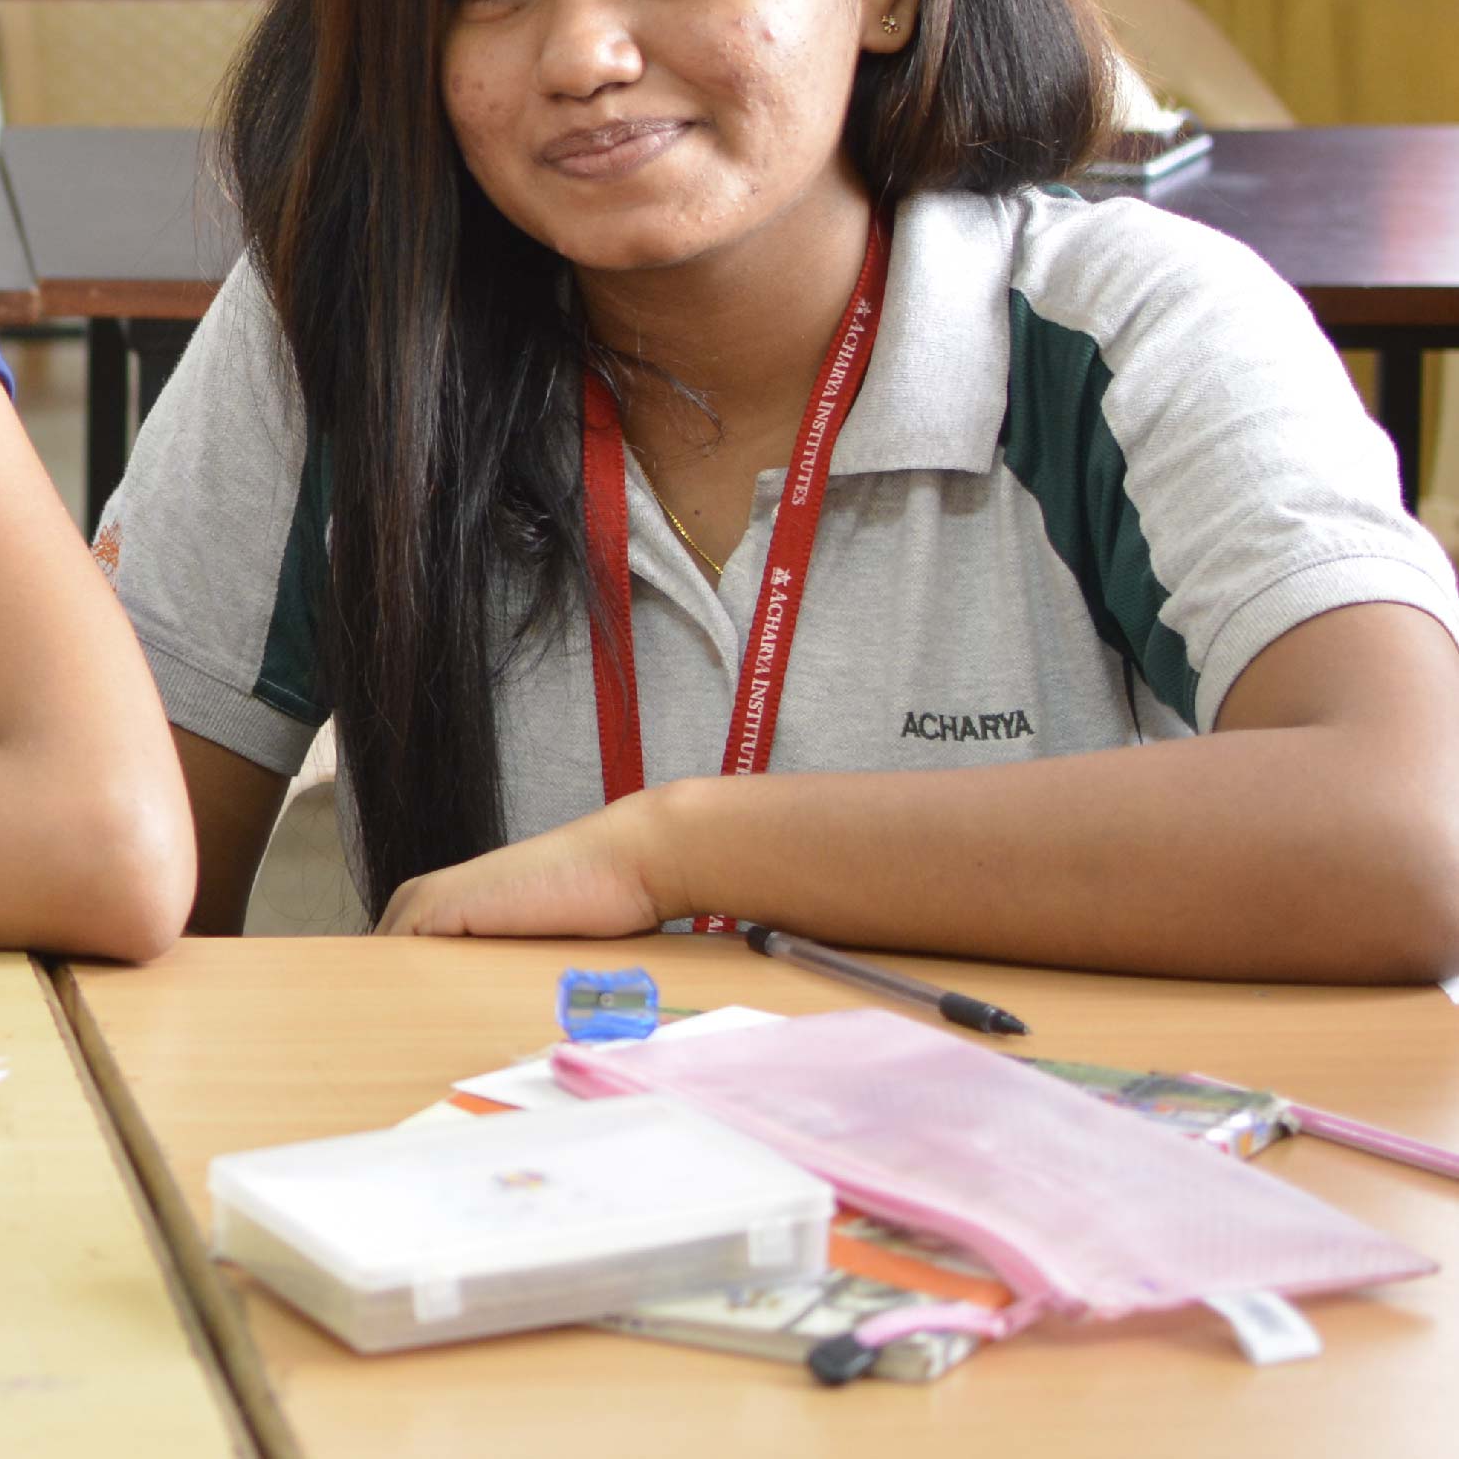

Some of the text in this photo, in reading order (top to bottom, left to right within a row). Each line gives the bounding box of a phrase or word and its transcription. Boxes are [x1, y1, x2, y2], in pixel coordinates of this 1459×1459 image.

[792, 317, 866, 506] ACHARYA INSTITUTES
[754, 588, 788, 674] ACHARYA
[901, 710, 1035, 742] ACHARYA
